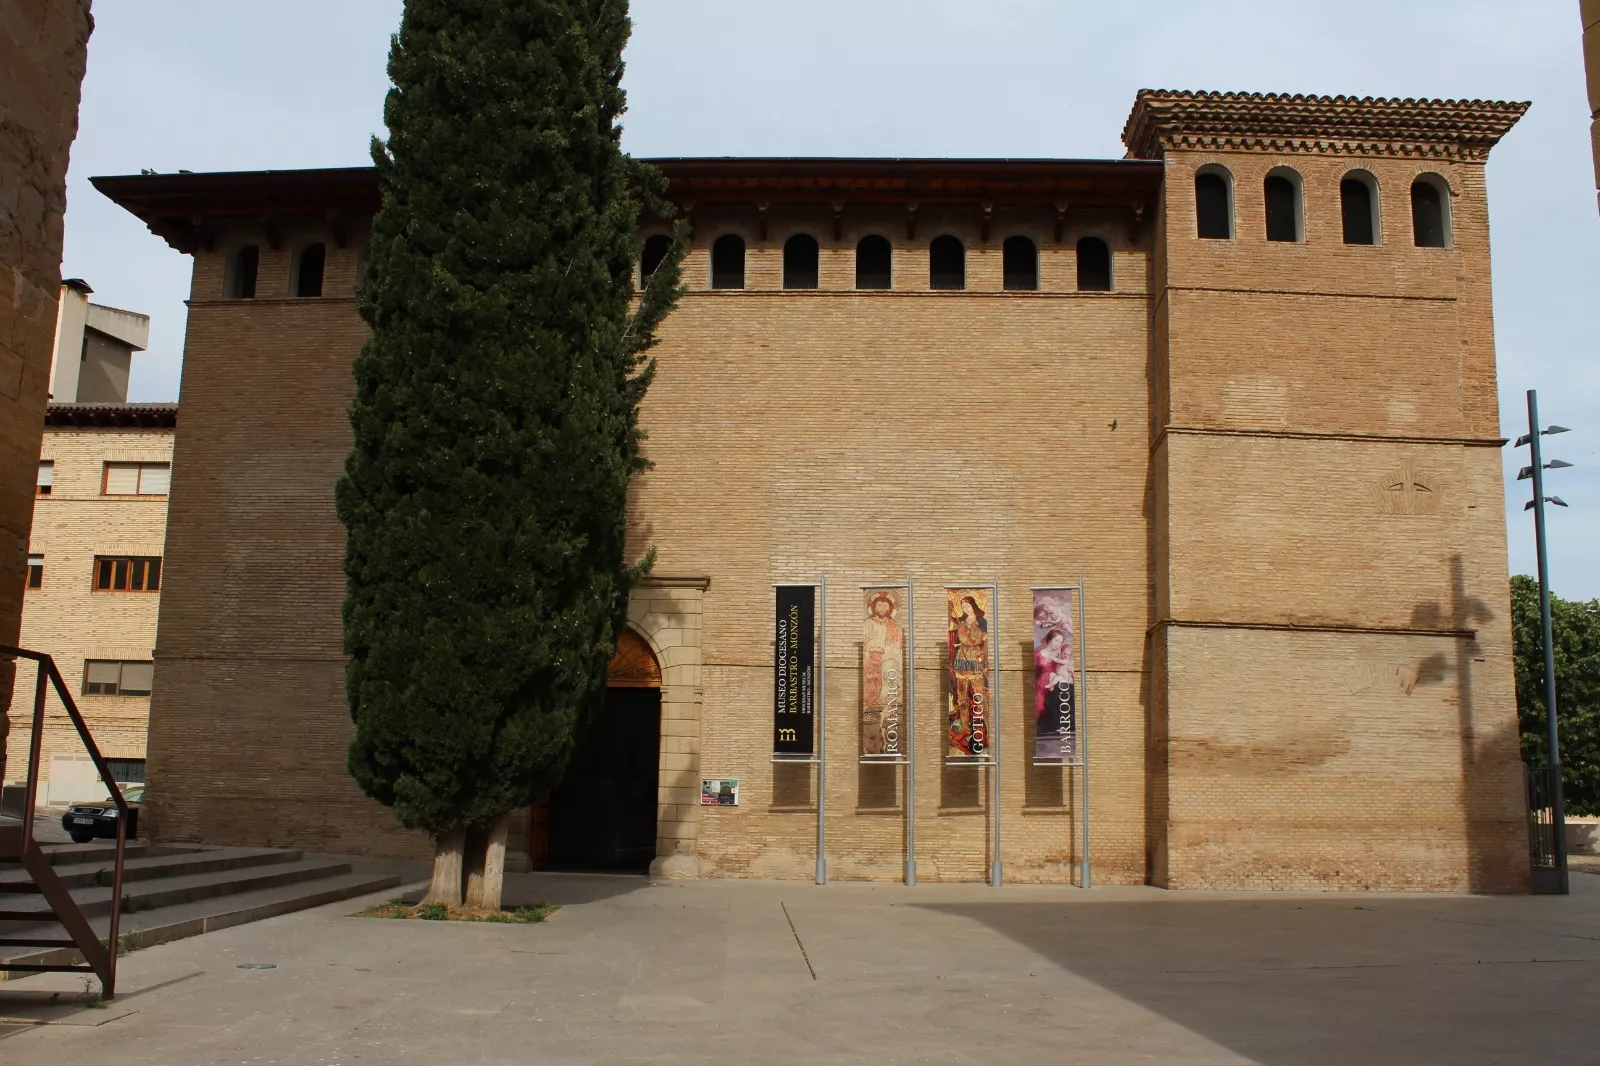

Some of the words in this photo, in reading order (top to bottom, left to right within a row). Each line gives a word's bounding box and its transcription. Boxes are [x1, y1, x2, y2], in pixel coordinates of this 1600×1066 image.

[779, 619, 787, 677] DIOCESANO
[789, 604, 799, 649] MONZÓN
[778, 678, 787, 714] MUSEO
[789, 655, 798, 714] BARBASTRO
[1058, 680, 1071, 754] BARROCO
